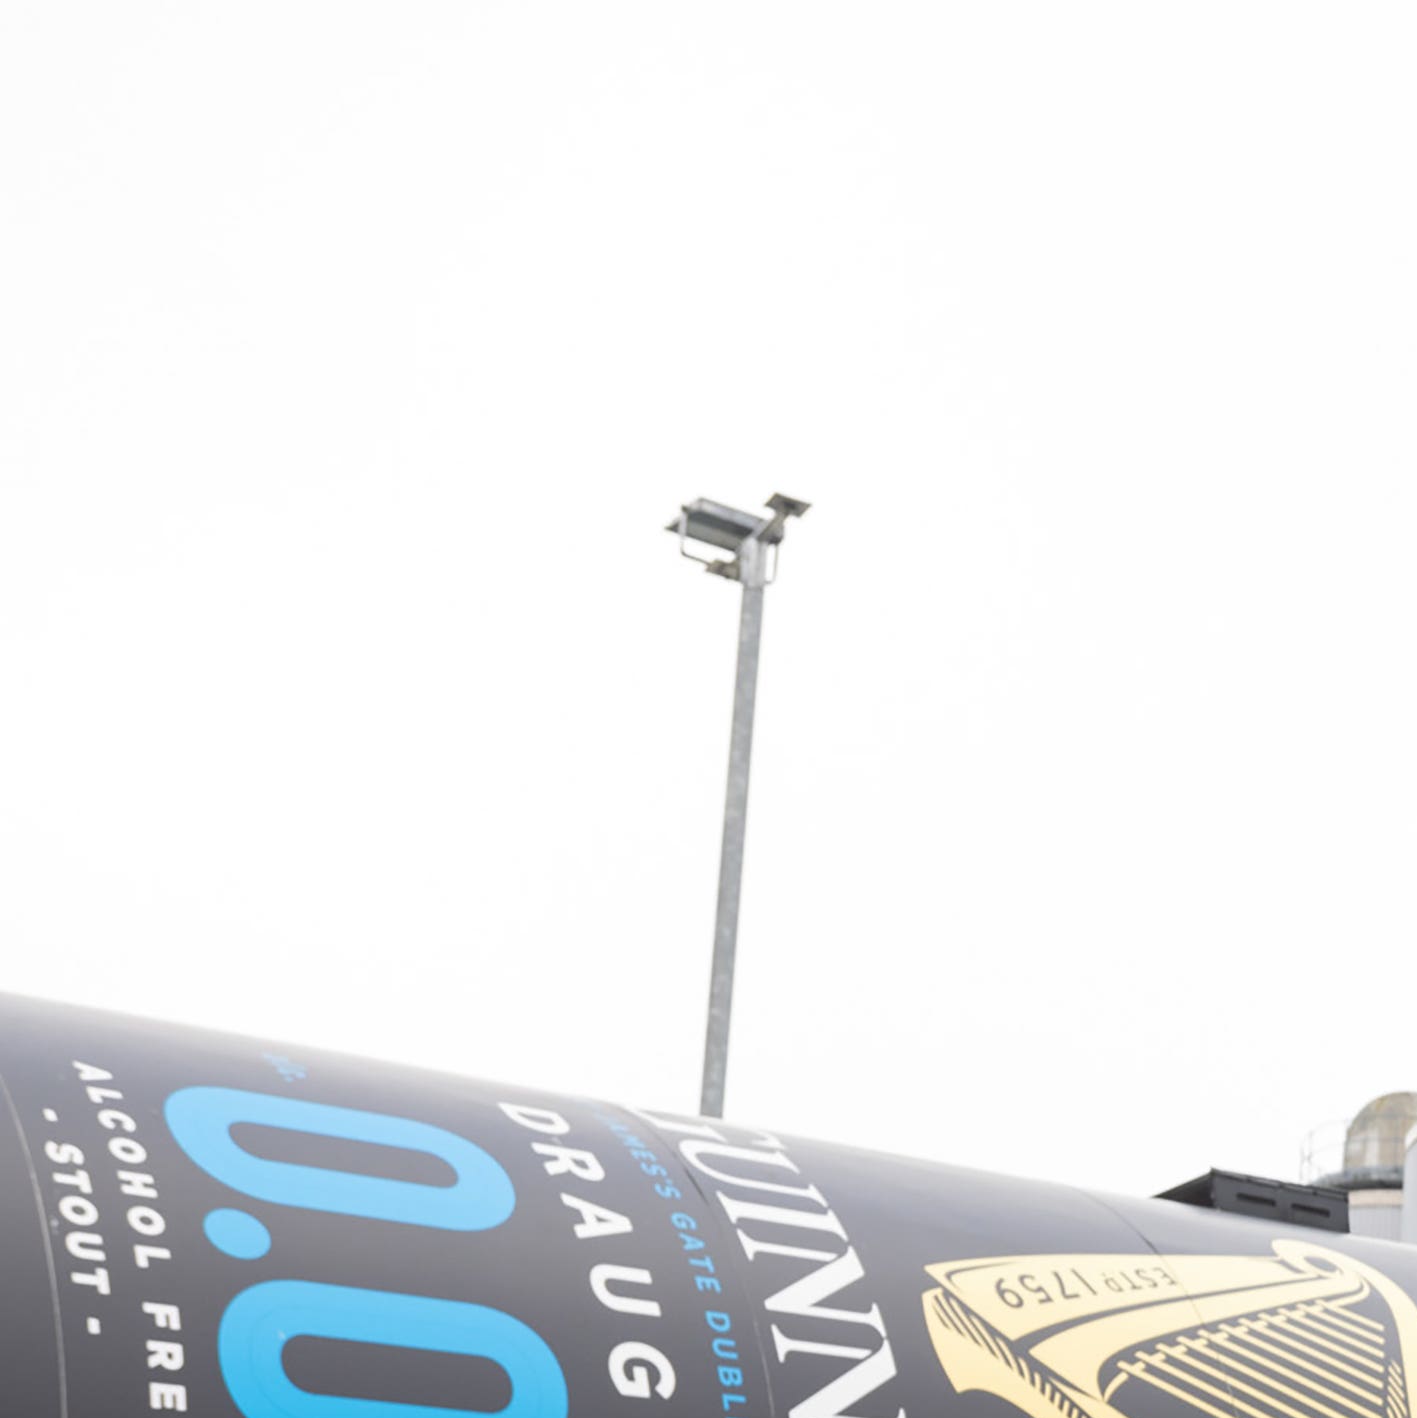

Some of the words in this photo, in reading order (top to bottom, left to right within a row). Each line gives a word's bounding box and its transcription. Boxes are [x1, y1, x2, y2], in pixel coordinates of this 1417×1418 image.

[44, 1140, 112, 1296] STOUT
[72, 1060, 171, 1269] ALCOHOL
[670, 1211, 723, 1294] GATE
[994, 1268, 1098, 1310] 1759
